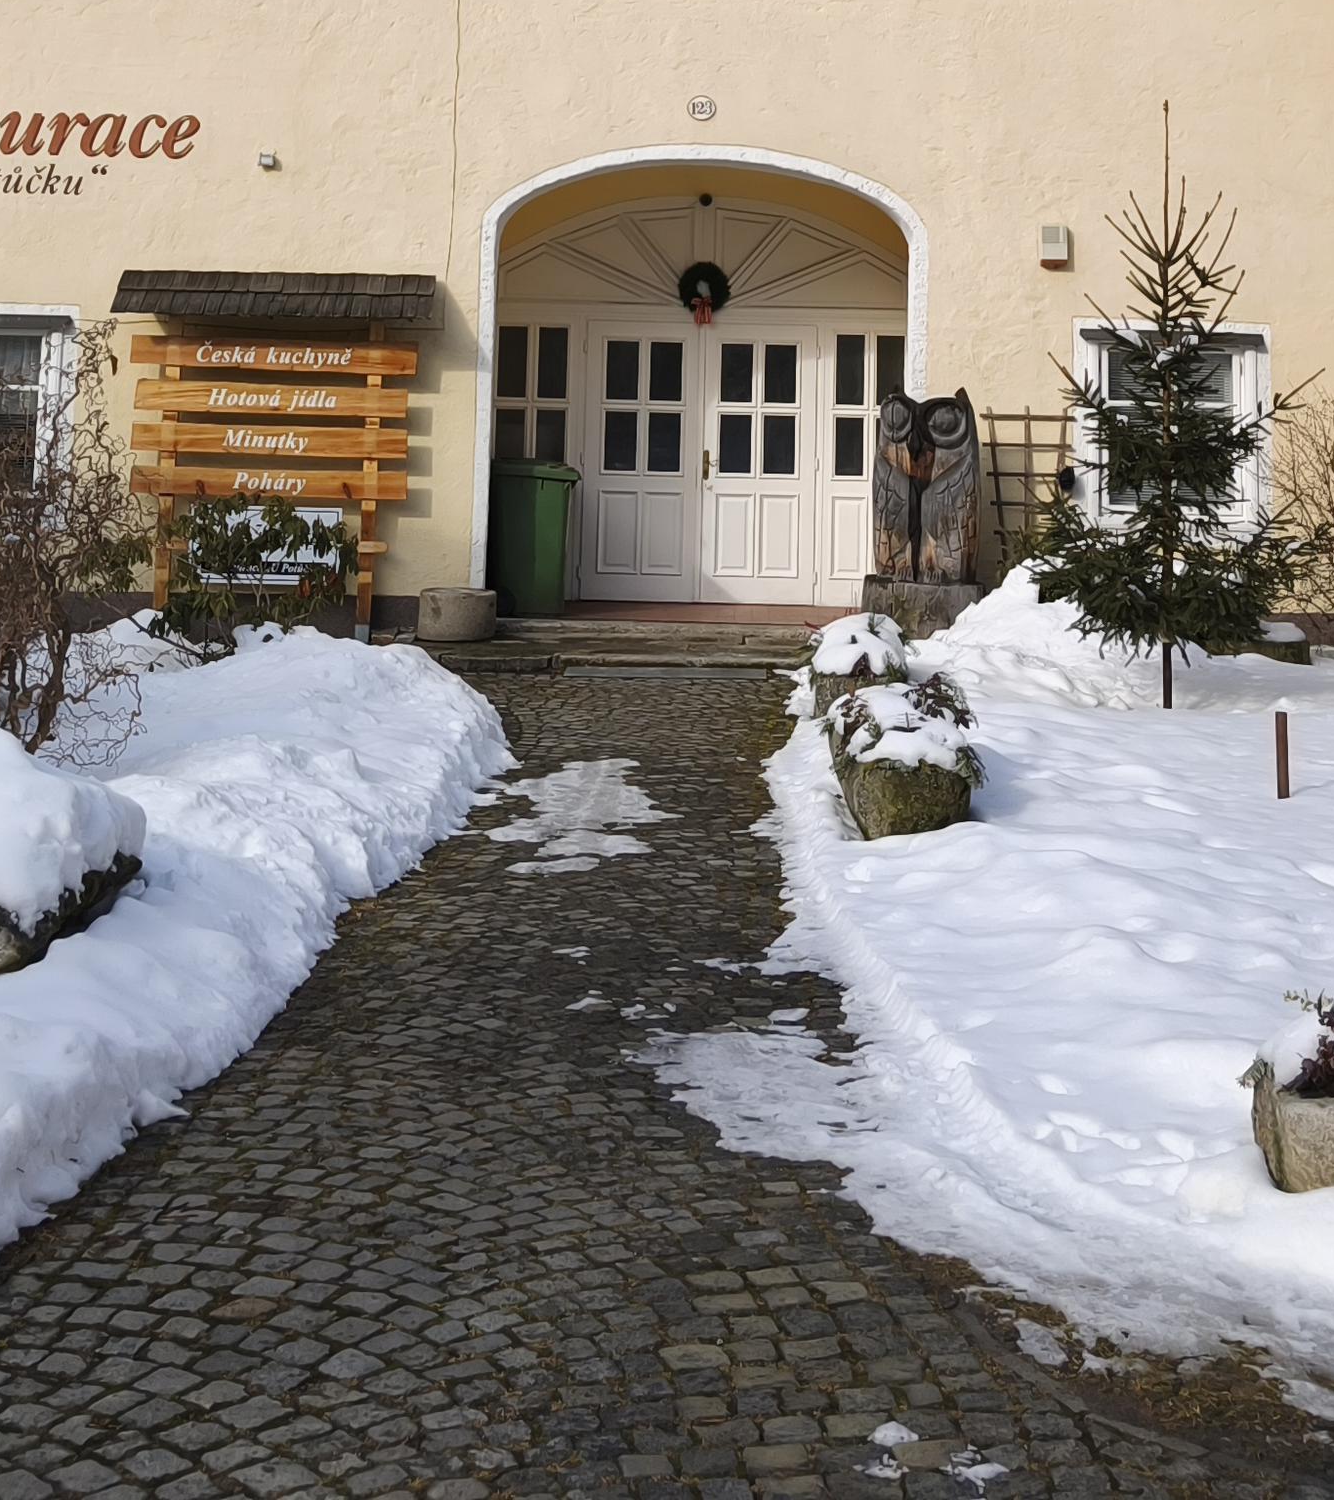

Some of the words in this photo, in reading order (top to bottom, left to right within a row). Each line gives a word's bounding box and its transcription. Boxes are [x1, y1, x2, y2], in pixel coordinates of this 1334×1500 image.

[691, 100, 713, 115] 123
[196, 340, 257, 364] Česká
[266, 346, 353, 369] kuchyně
[208, 388, 281, 407] Hotová
[287, 389, 338, 411] jídla
[222, 428, 309, 454] Minutky
[232, 471, 307, 496] Poháry
